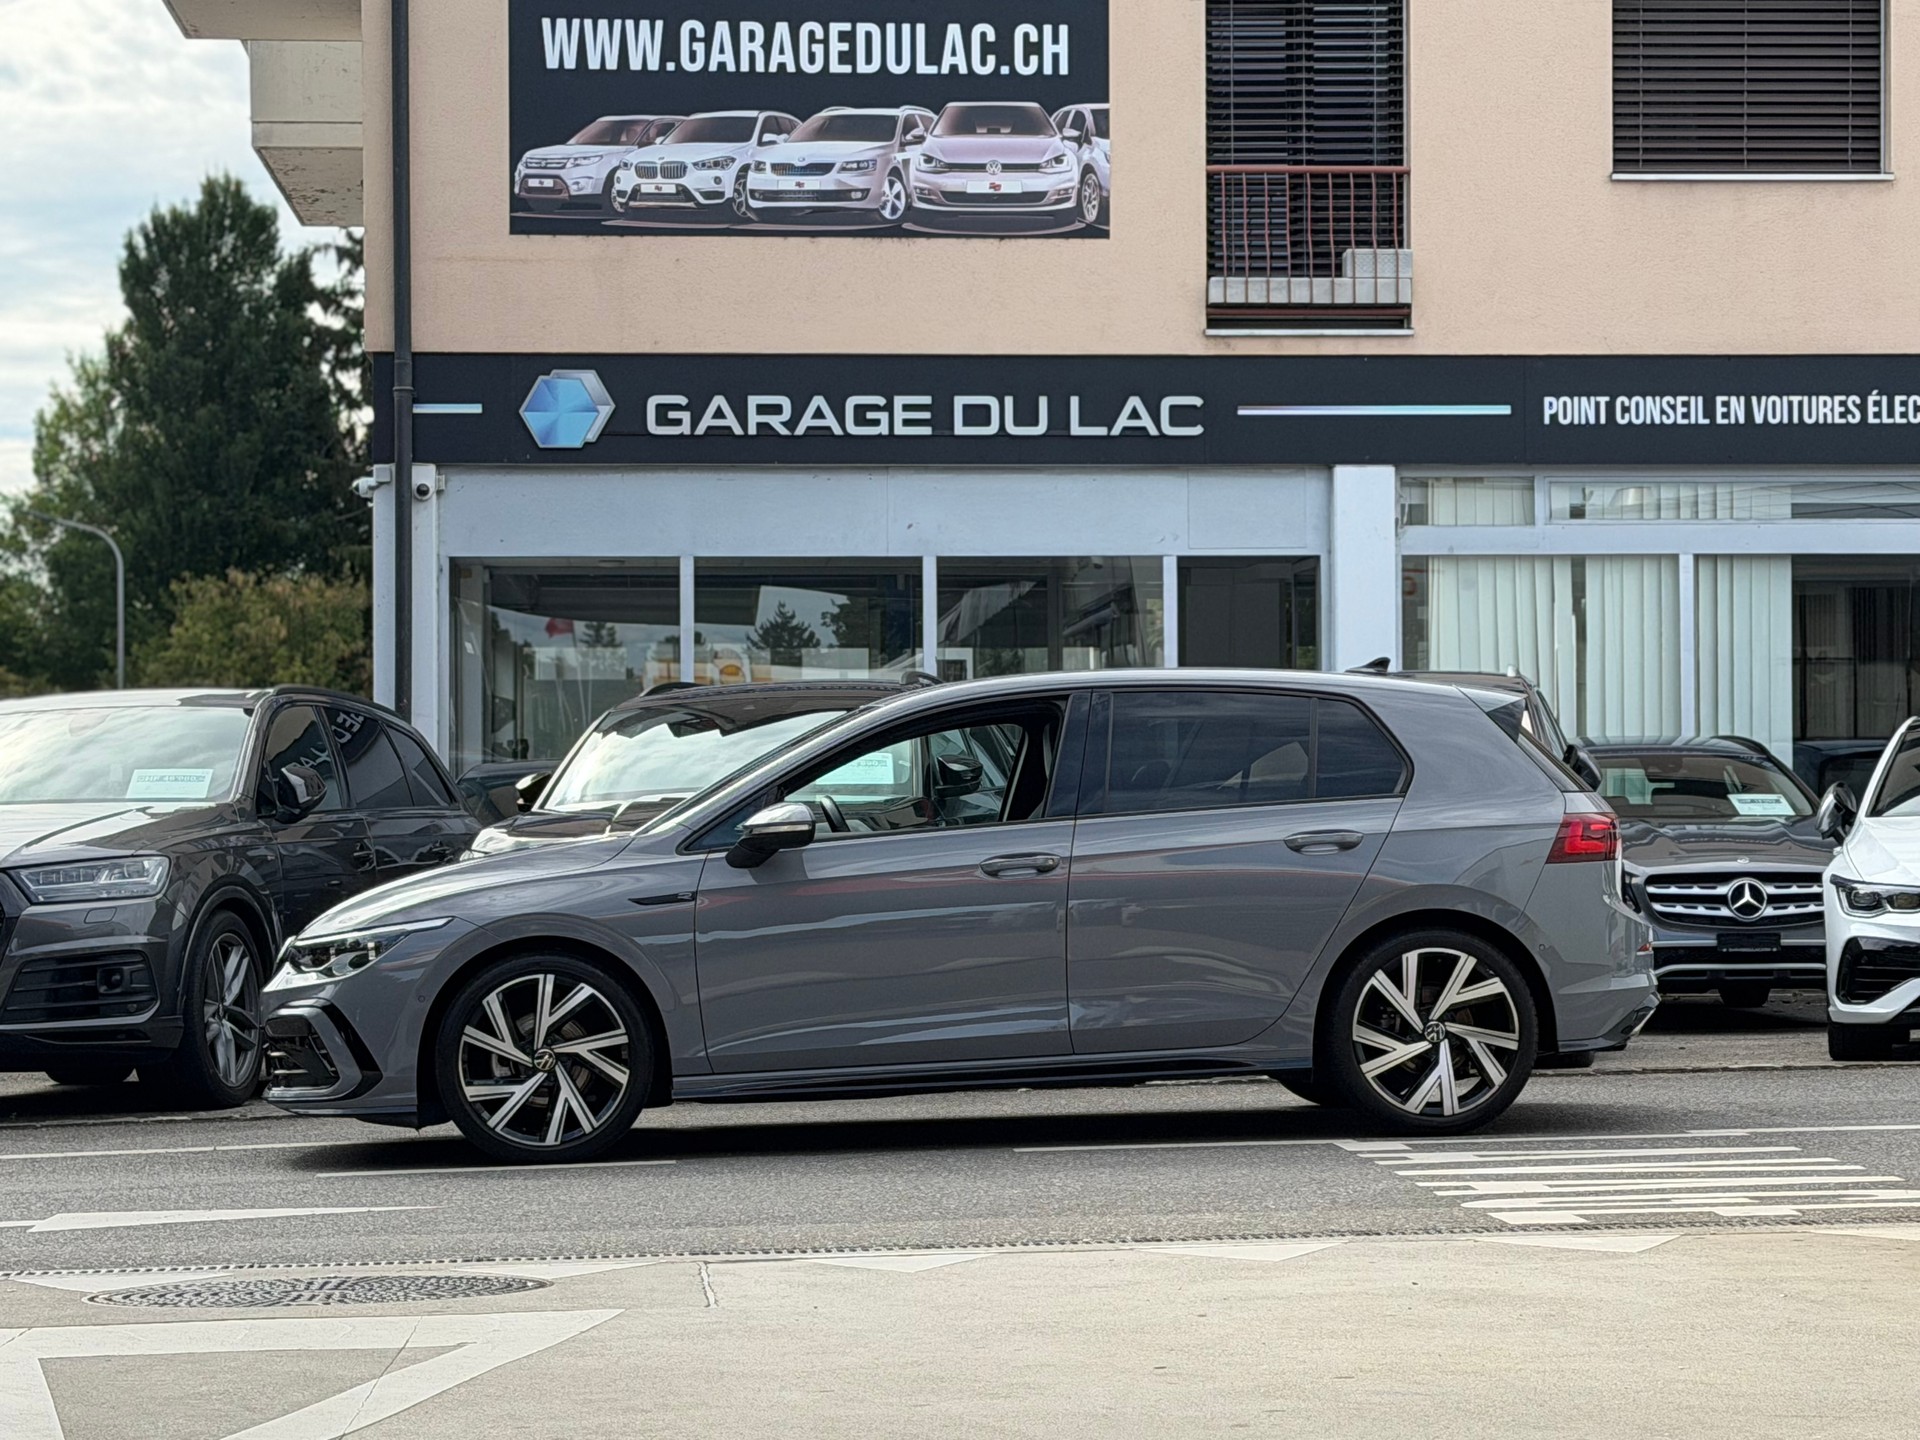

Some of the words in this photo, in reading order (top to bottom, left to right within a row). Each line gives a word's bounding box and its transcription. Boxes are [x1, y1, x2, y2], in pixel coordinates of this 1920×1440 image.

[541, 17, 1069, 76] WWW.GARAGEDULAC.CH
[646, 395, 933, 436] GARAGE
[953, 395, 1048, 436] DU
[1069, 395, 1205, 436] LAC
[1543, 395, 1611, 425] POINT
[1615, 395, 1711, 425] CONSEIL
[1715, 395, 1745, 425] EN
[1750, 395, 1862, 425] VOITURES
[1867, 389, 1920, 424] ÉLEC
